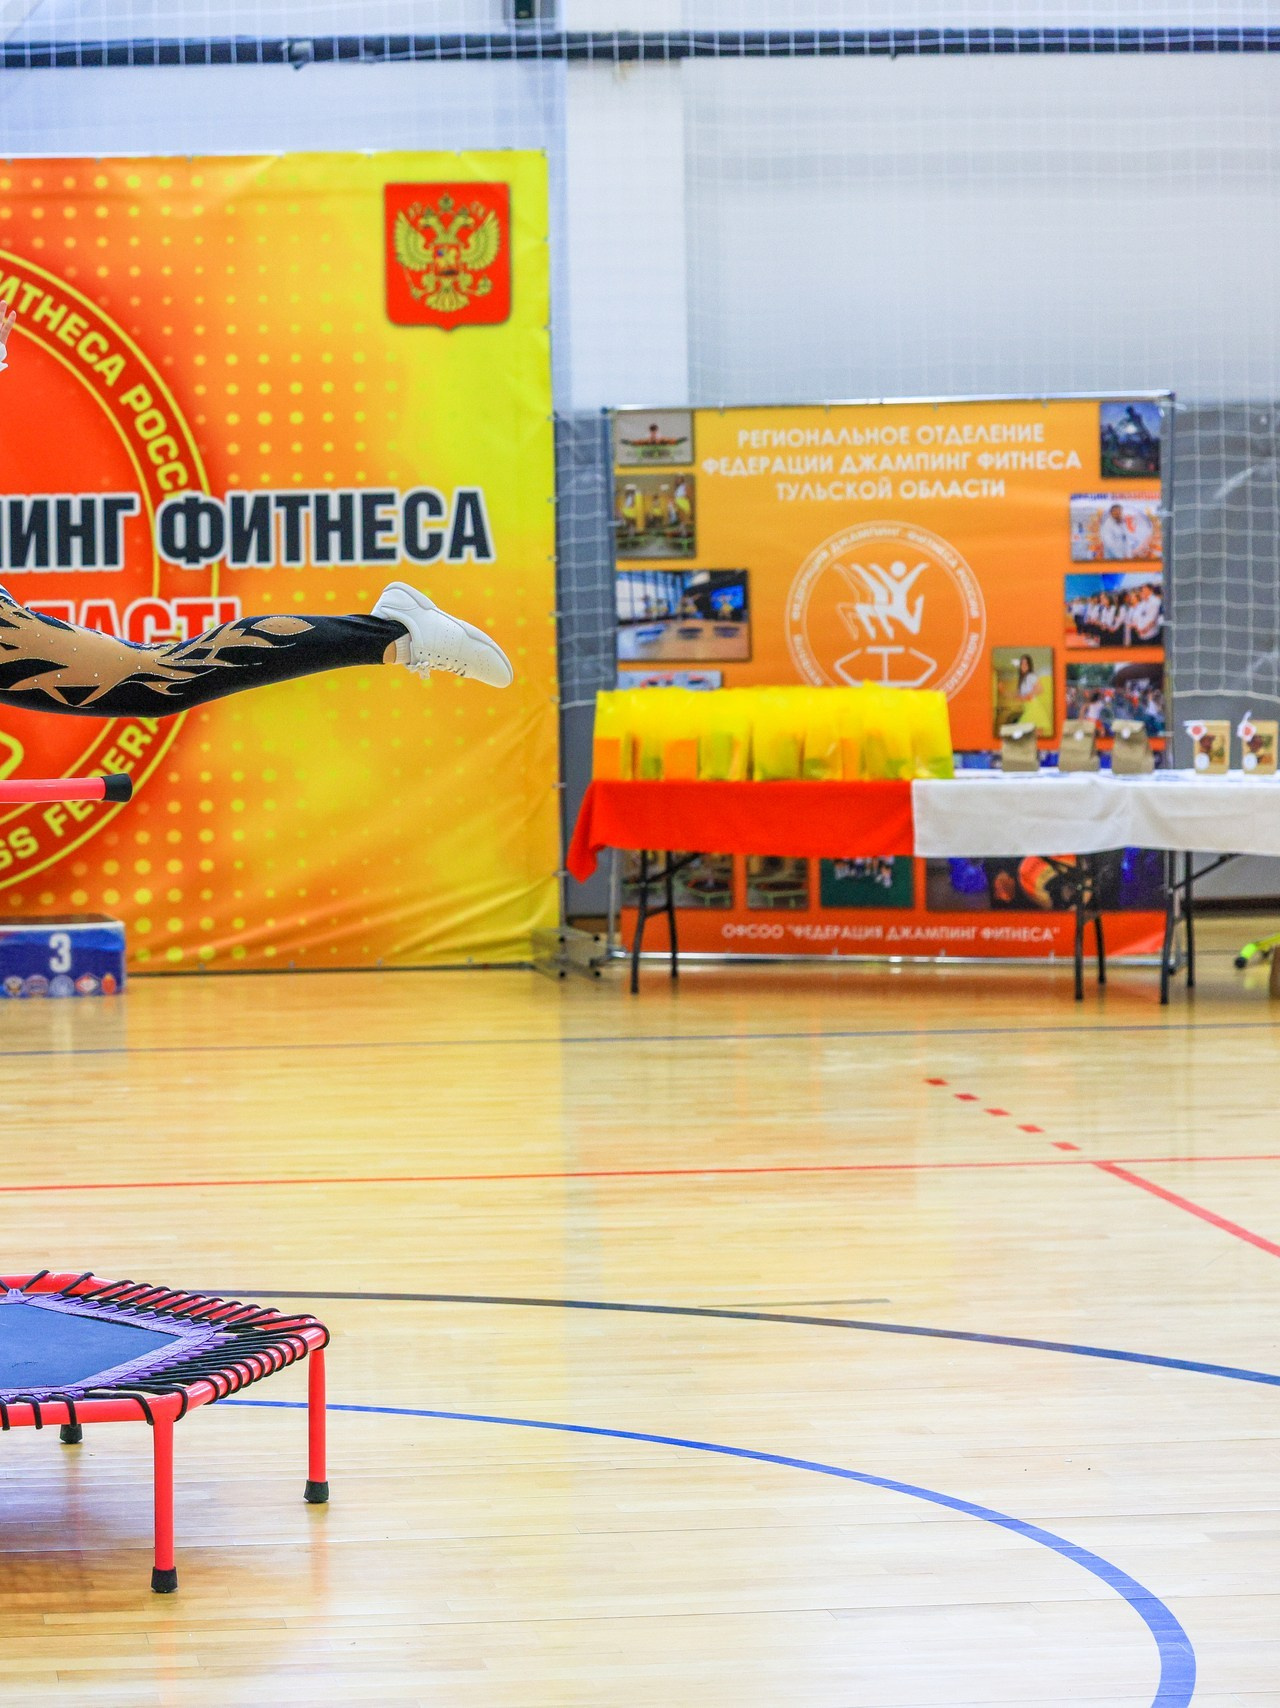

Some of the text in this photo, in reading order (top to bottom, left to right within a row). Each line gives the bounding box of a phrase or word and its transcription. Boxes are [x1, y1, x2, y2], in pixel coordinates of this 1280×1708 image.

[119, 384, 192, 500] РОСС
[737, 423, 1045, 449] РЕГИОНАЛЬНОЕ ОТДЕЛЕНИЕ
[702, 449, 1082, 477] ФЕДЕРАЦИИ ДЖАМПИНГ ФИТНЕСА
[776, 475, 1006, 501] ТУЛЬСКОЙ ОБЛАСТИ
[157, 487, 497, 570] ФИТНЕСА
[48, 932, 72, 973] 3
